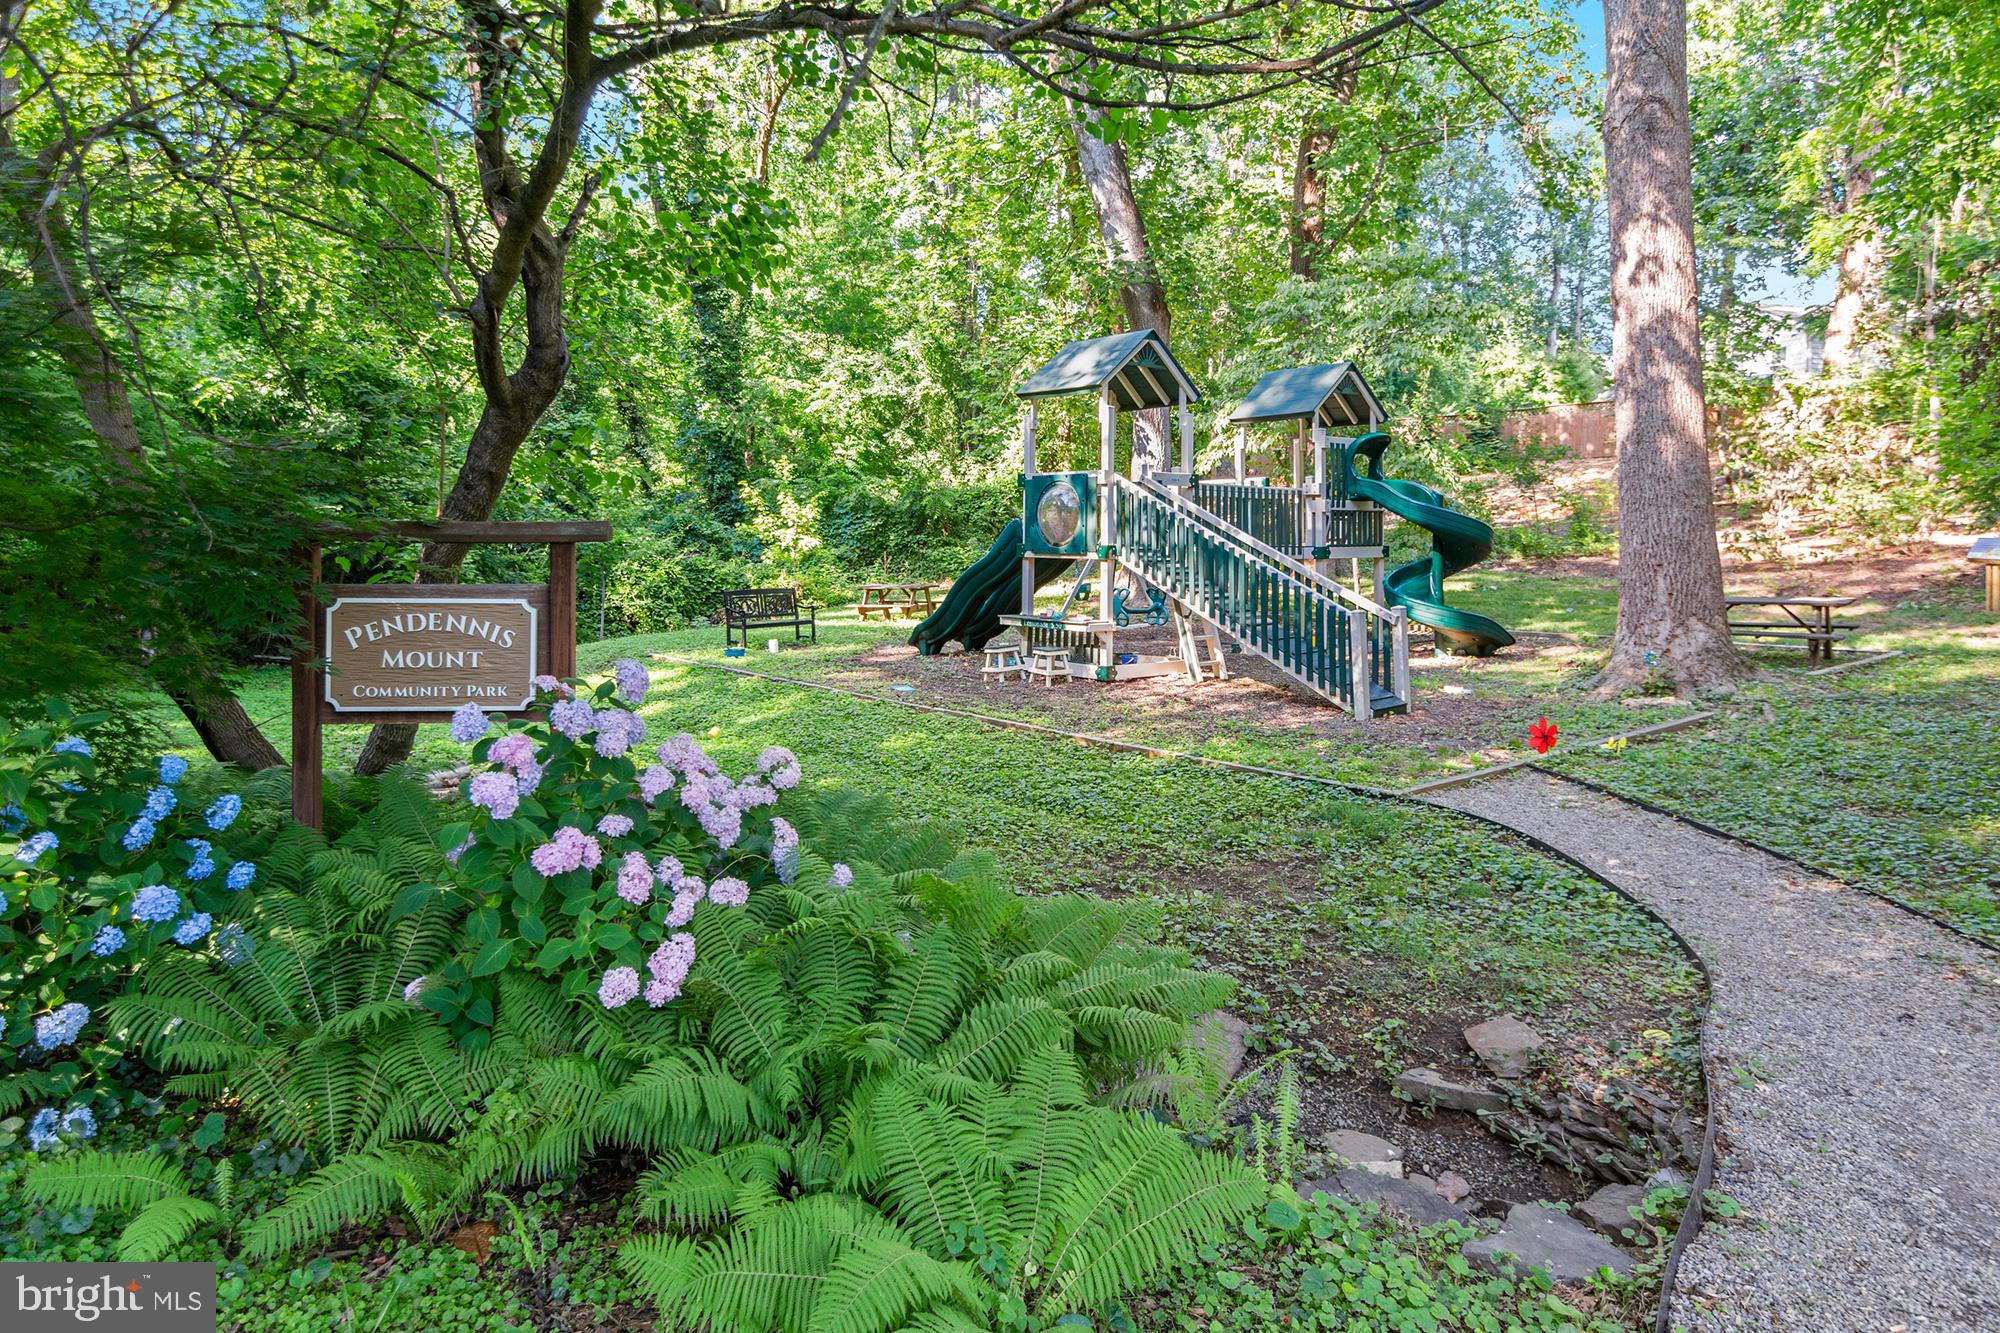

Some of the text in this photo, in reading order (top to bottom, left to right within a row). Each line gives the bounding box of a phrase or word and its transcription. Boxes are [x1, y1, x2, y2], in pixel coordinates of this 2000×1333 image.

[343, 612, 516, 650] PENDENNIS
[381, 650, 484, 668] MOUNT
[352, 685, 508, 697] COMMUNITY PARK
